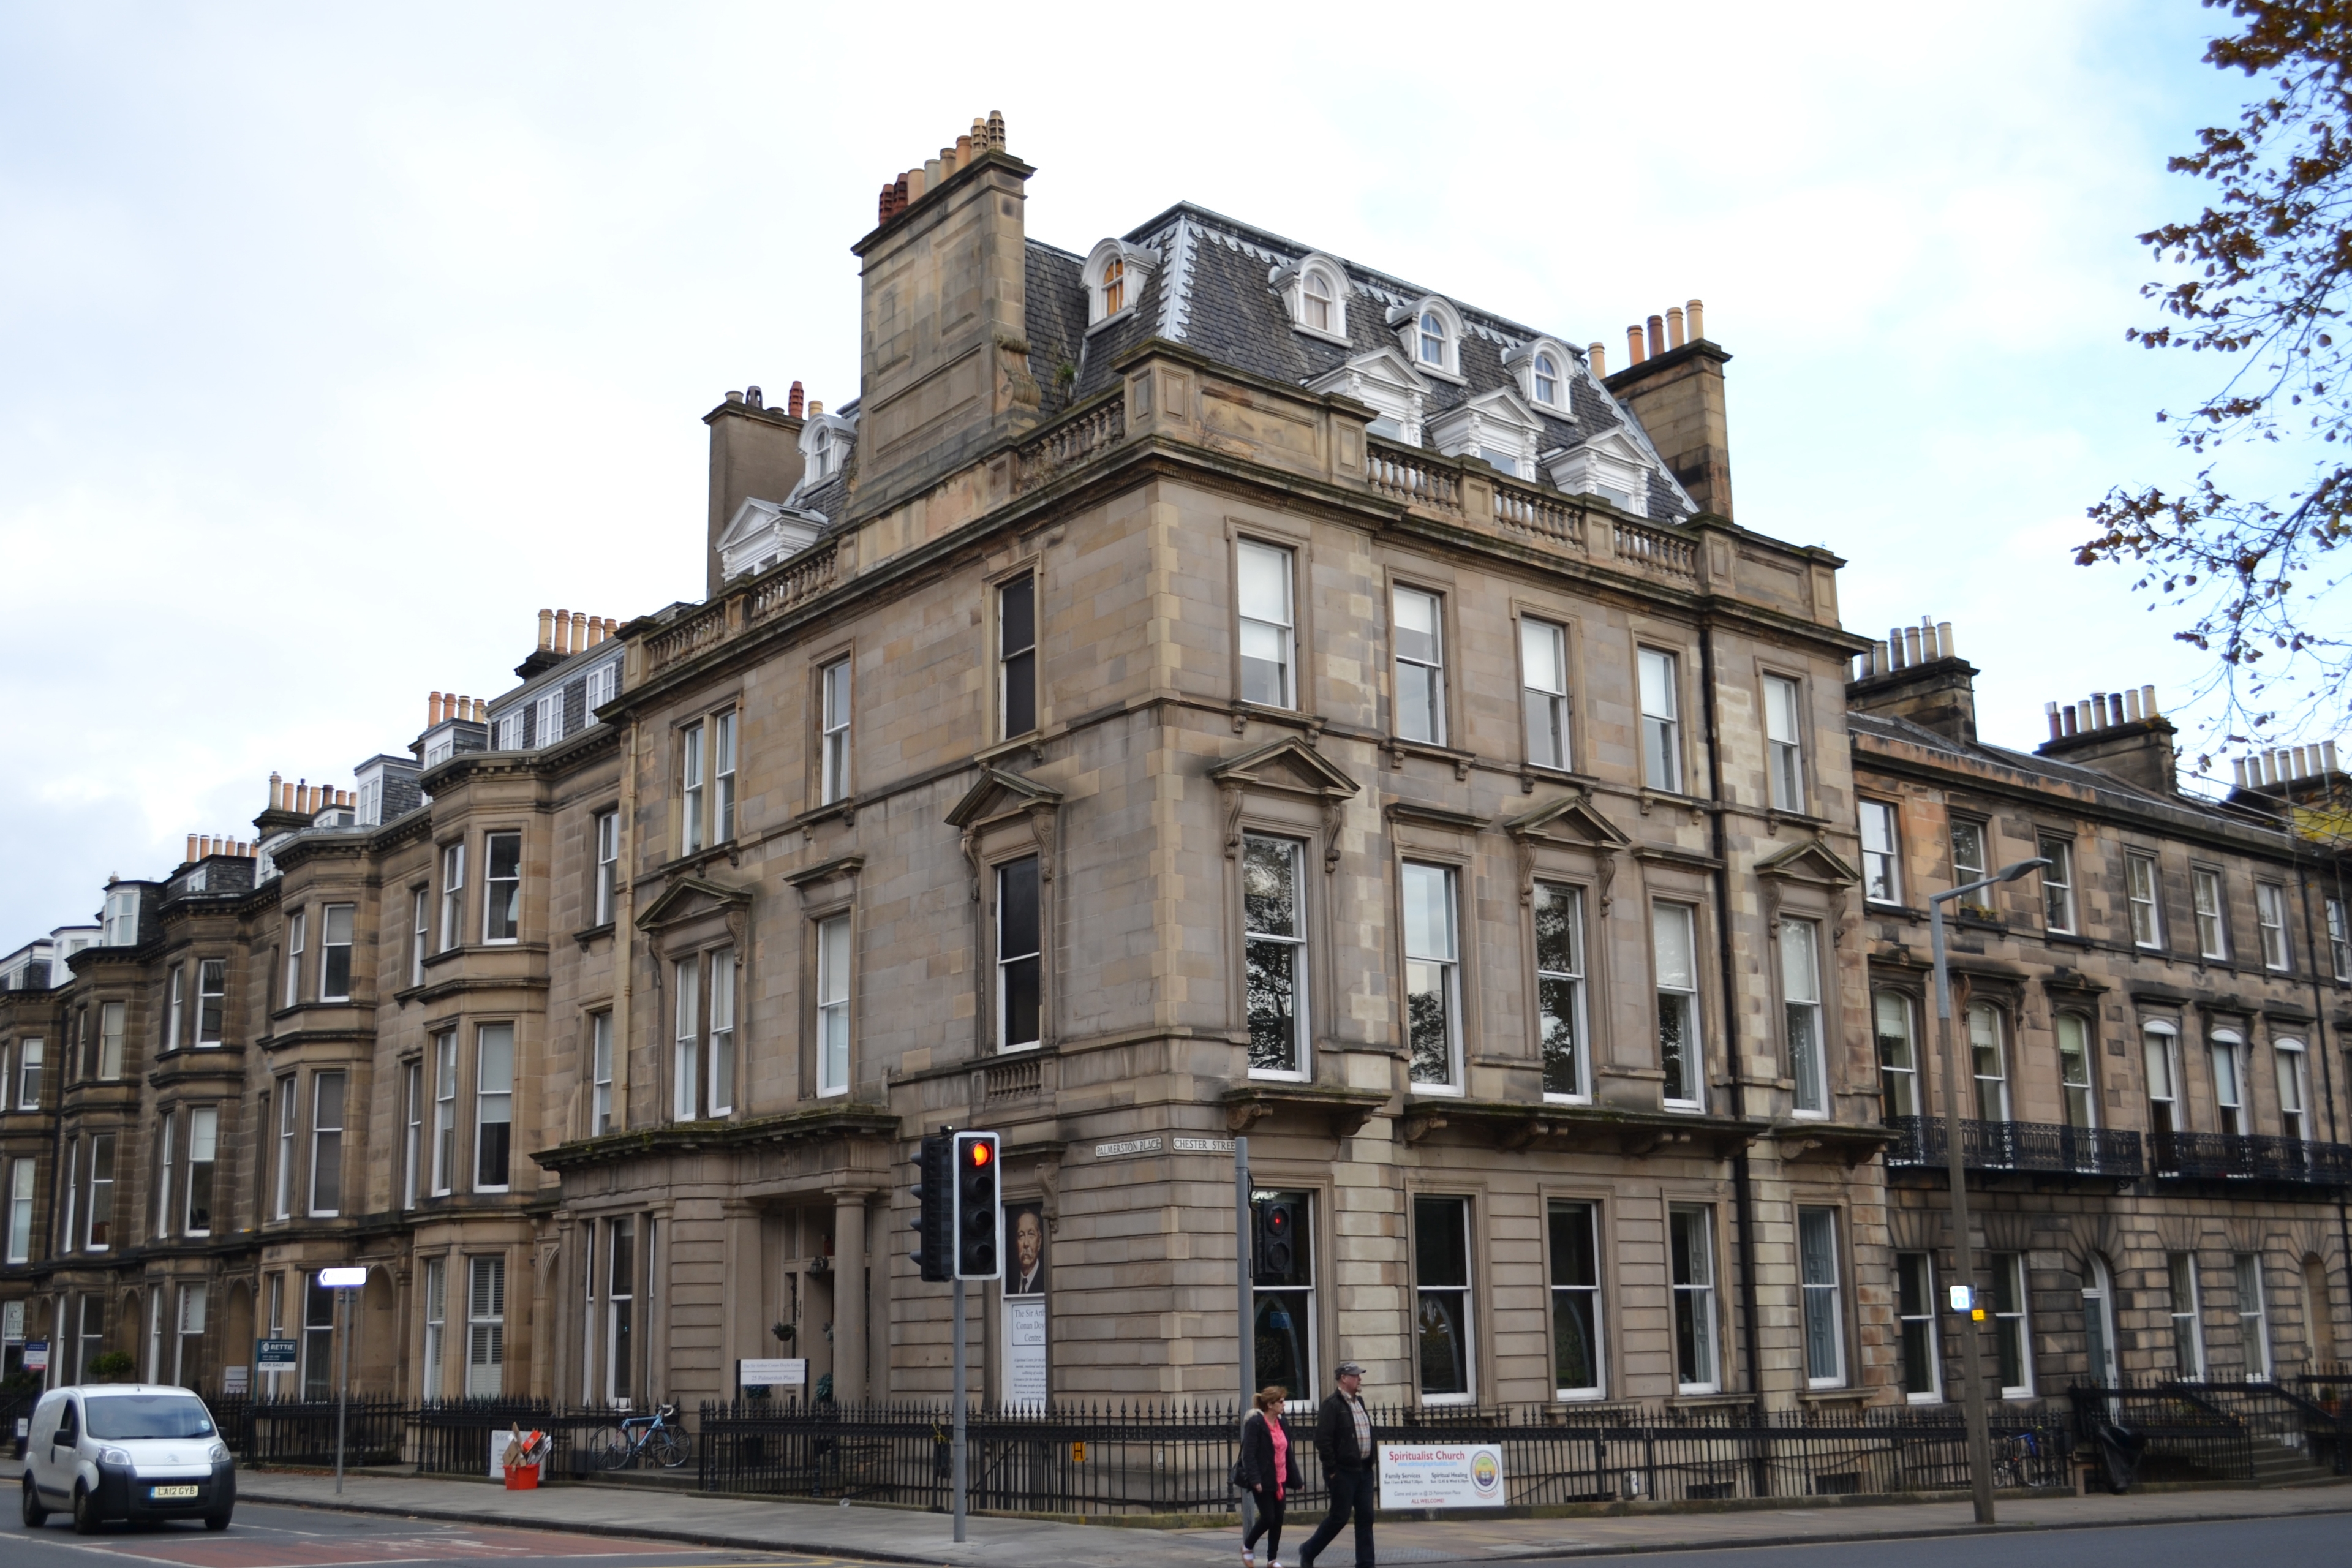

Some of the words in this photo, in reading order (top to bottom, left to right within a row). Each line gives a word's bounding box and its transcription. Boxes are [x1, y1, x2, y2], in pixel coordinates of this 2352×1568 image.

[1097, 1142, 1137, 1155] PALMERSTON
[1140, 1139, 1160, 1150] PLACE
[1174, 1140, 1207, 1149] CHESTER
[1212, 1141, 1235, 1150] STREE
[1034, 1308, 1045, 1317] Arth
[1034, 1321, 1044, 1331] Doy
[1074, 1442, 1083, 1459] H
[1389, 1451, 1433, 1463] Spiritualist
[1436, 1450, 1465, 1460] Church
[158, 1487, 177, 1496] LA12
